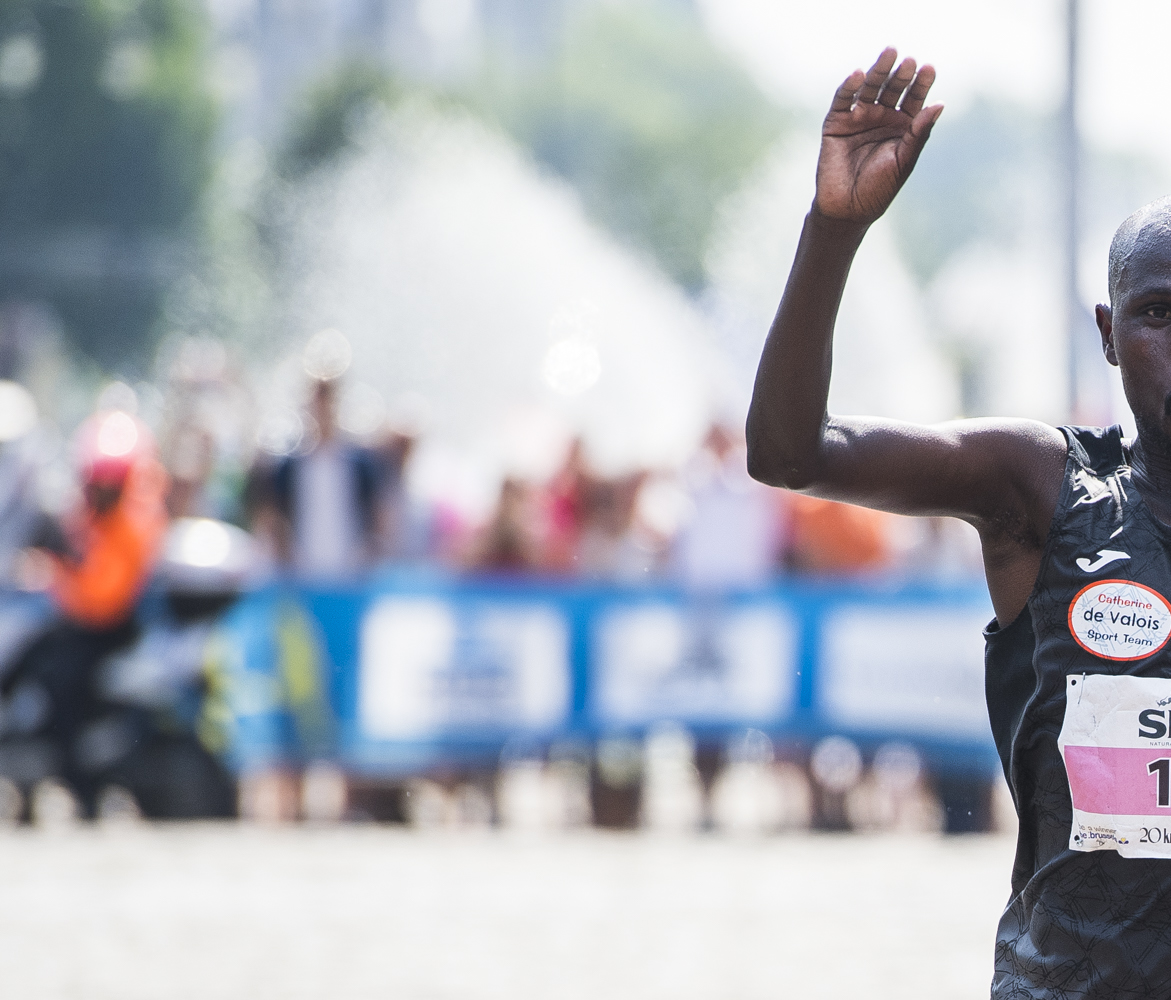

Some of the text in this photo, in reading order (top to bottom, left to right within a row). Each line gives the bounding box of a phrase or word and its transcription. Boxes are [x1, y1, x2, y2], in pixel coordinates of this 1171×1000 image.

[1098, 594, 1152, 609] Catherine
[1083, 608, 1160, 630] de Valois
[1087, 629, 1152, 646] Sport Team
